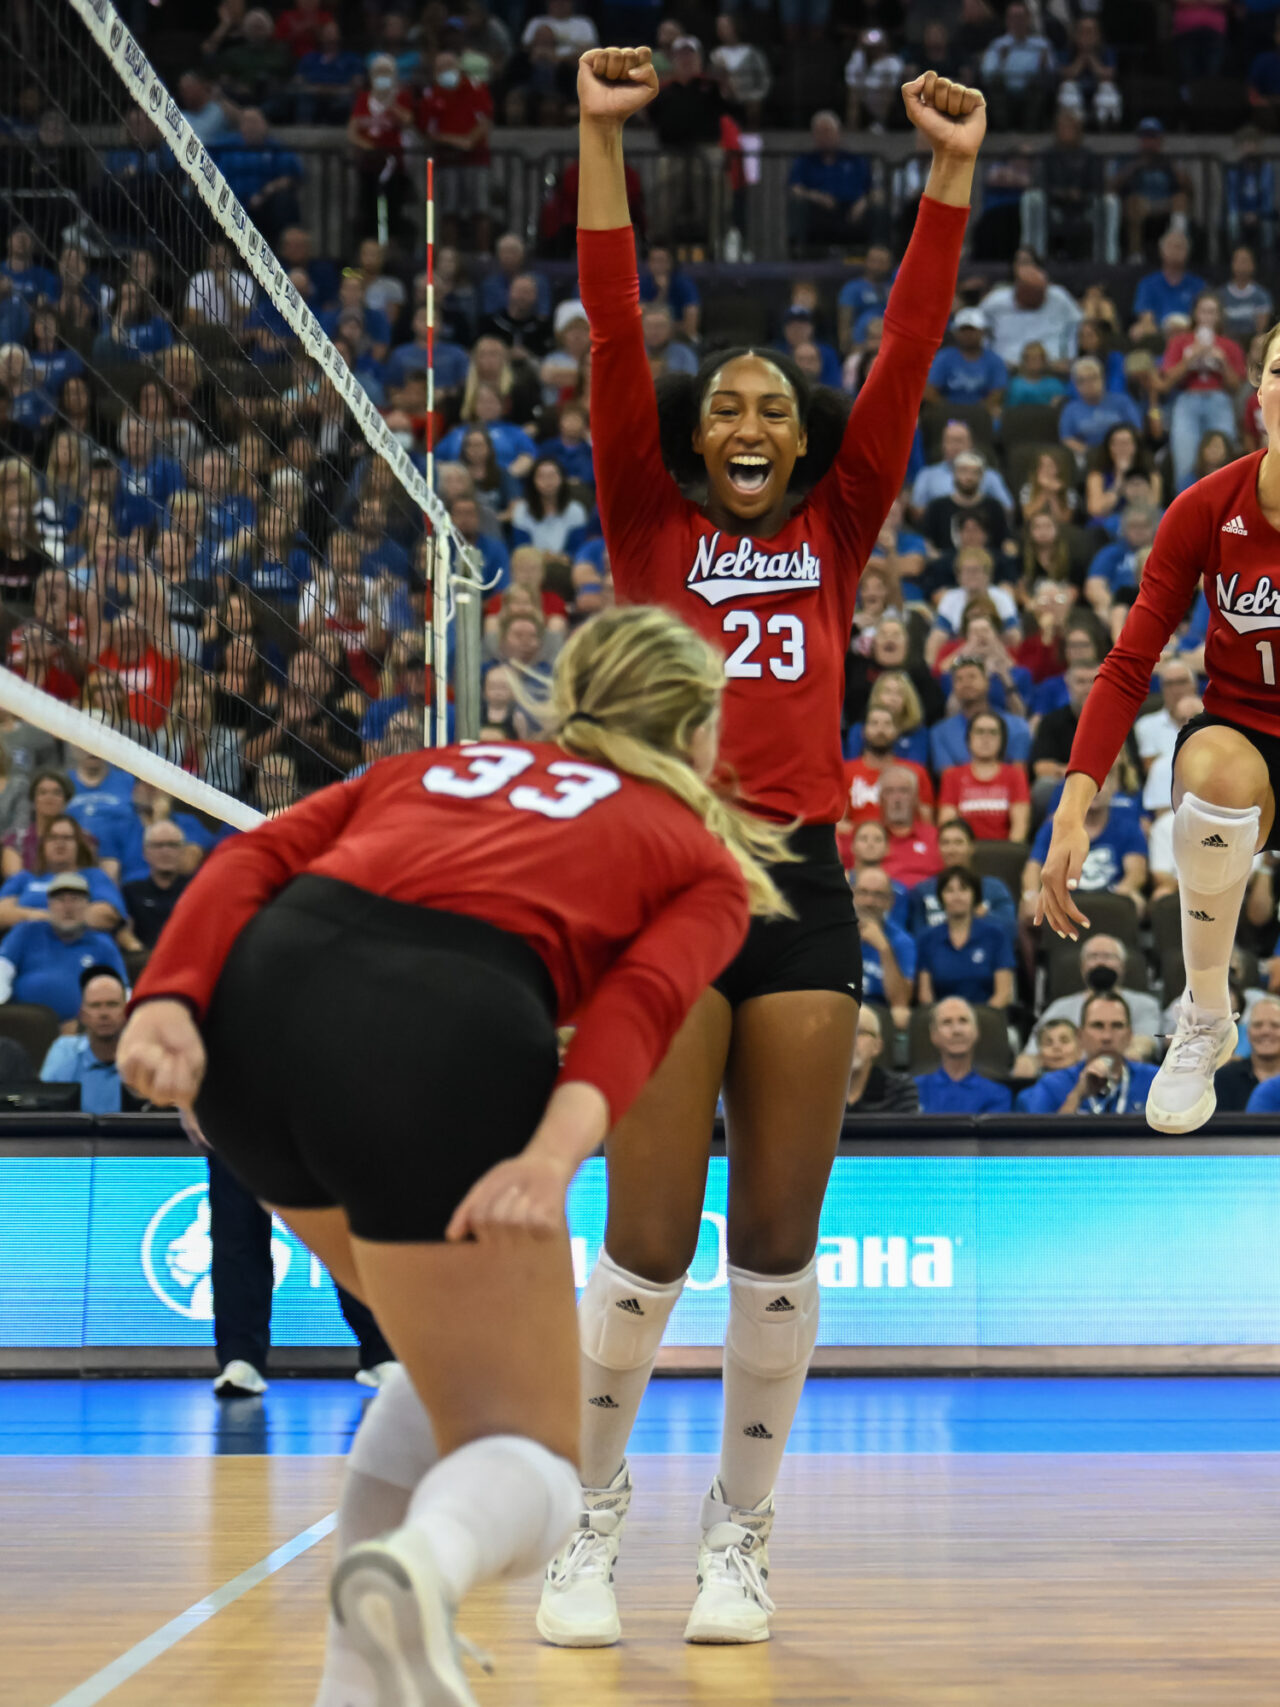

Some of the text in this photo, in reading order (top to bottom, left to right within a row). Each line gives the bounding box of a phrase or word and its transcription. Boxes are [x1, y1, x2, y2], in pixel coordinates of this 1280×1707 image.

[1221, 525, 1248, 536] adidas
[722, 610, 806, 682] 23
[422, 744, 623, 819] 33
